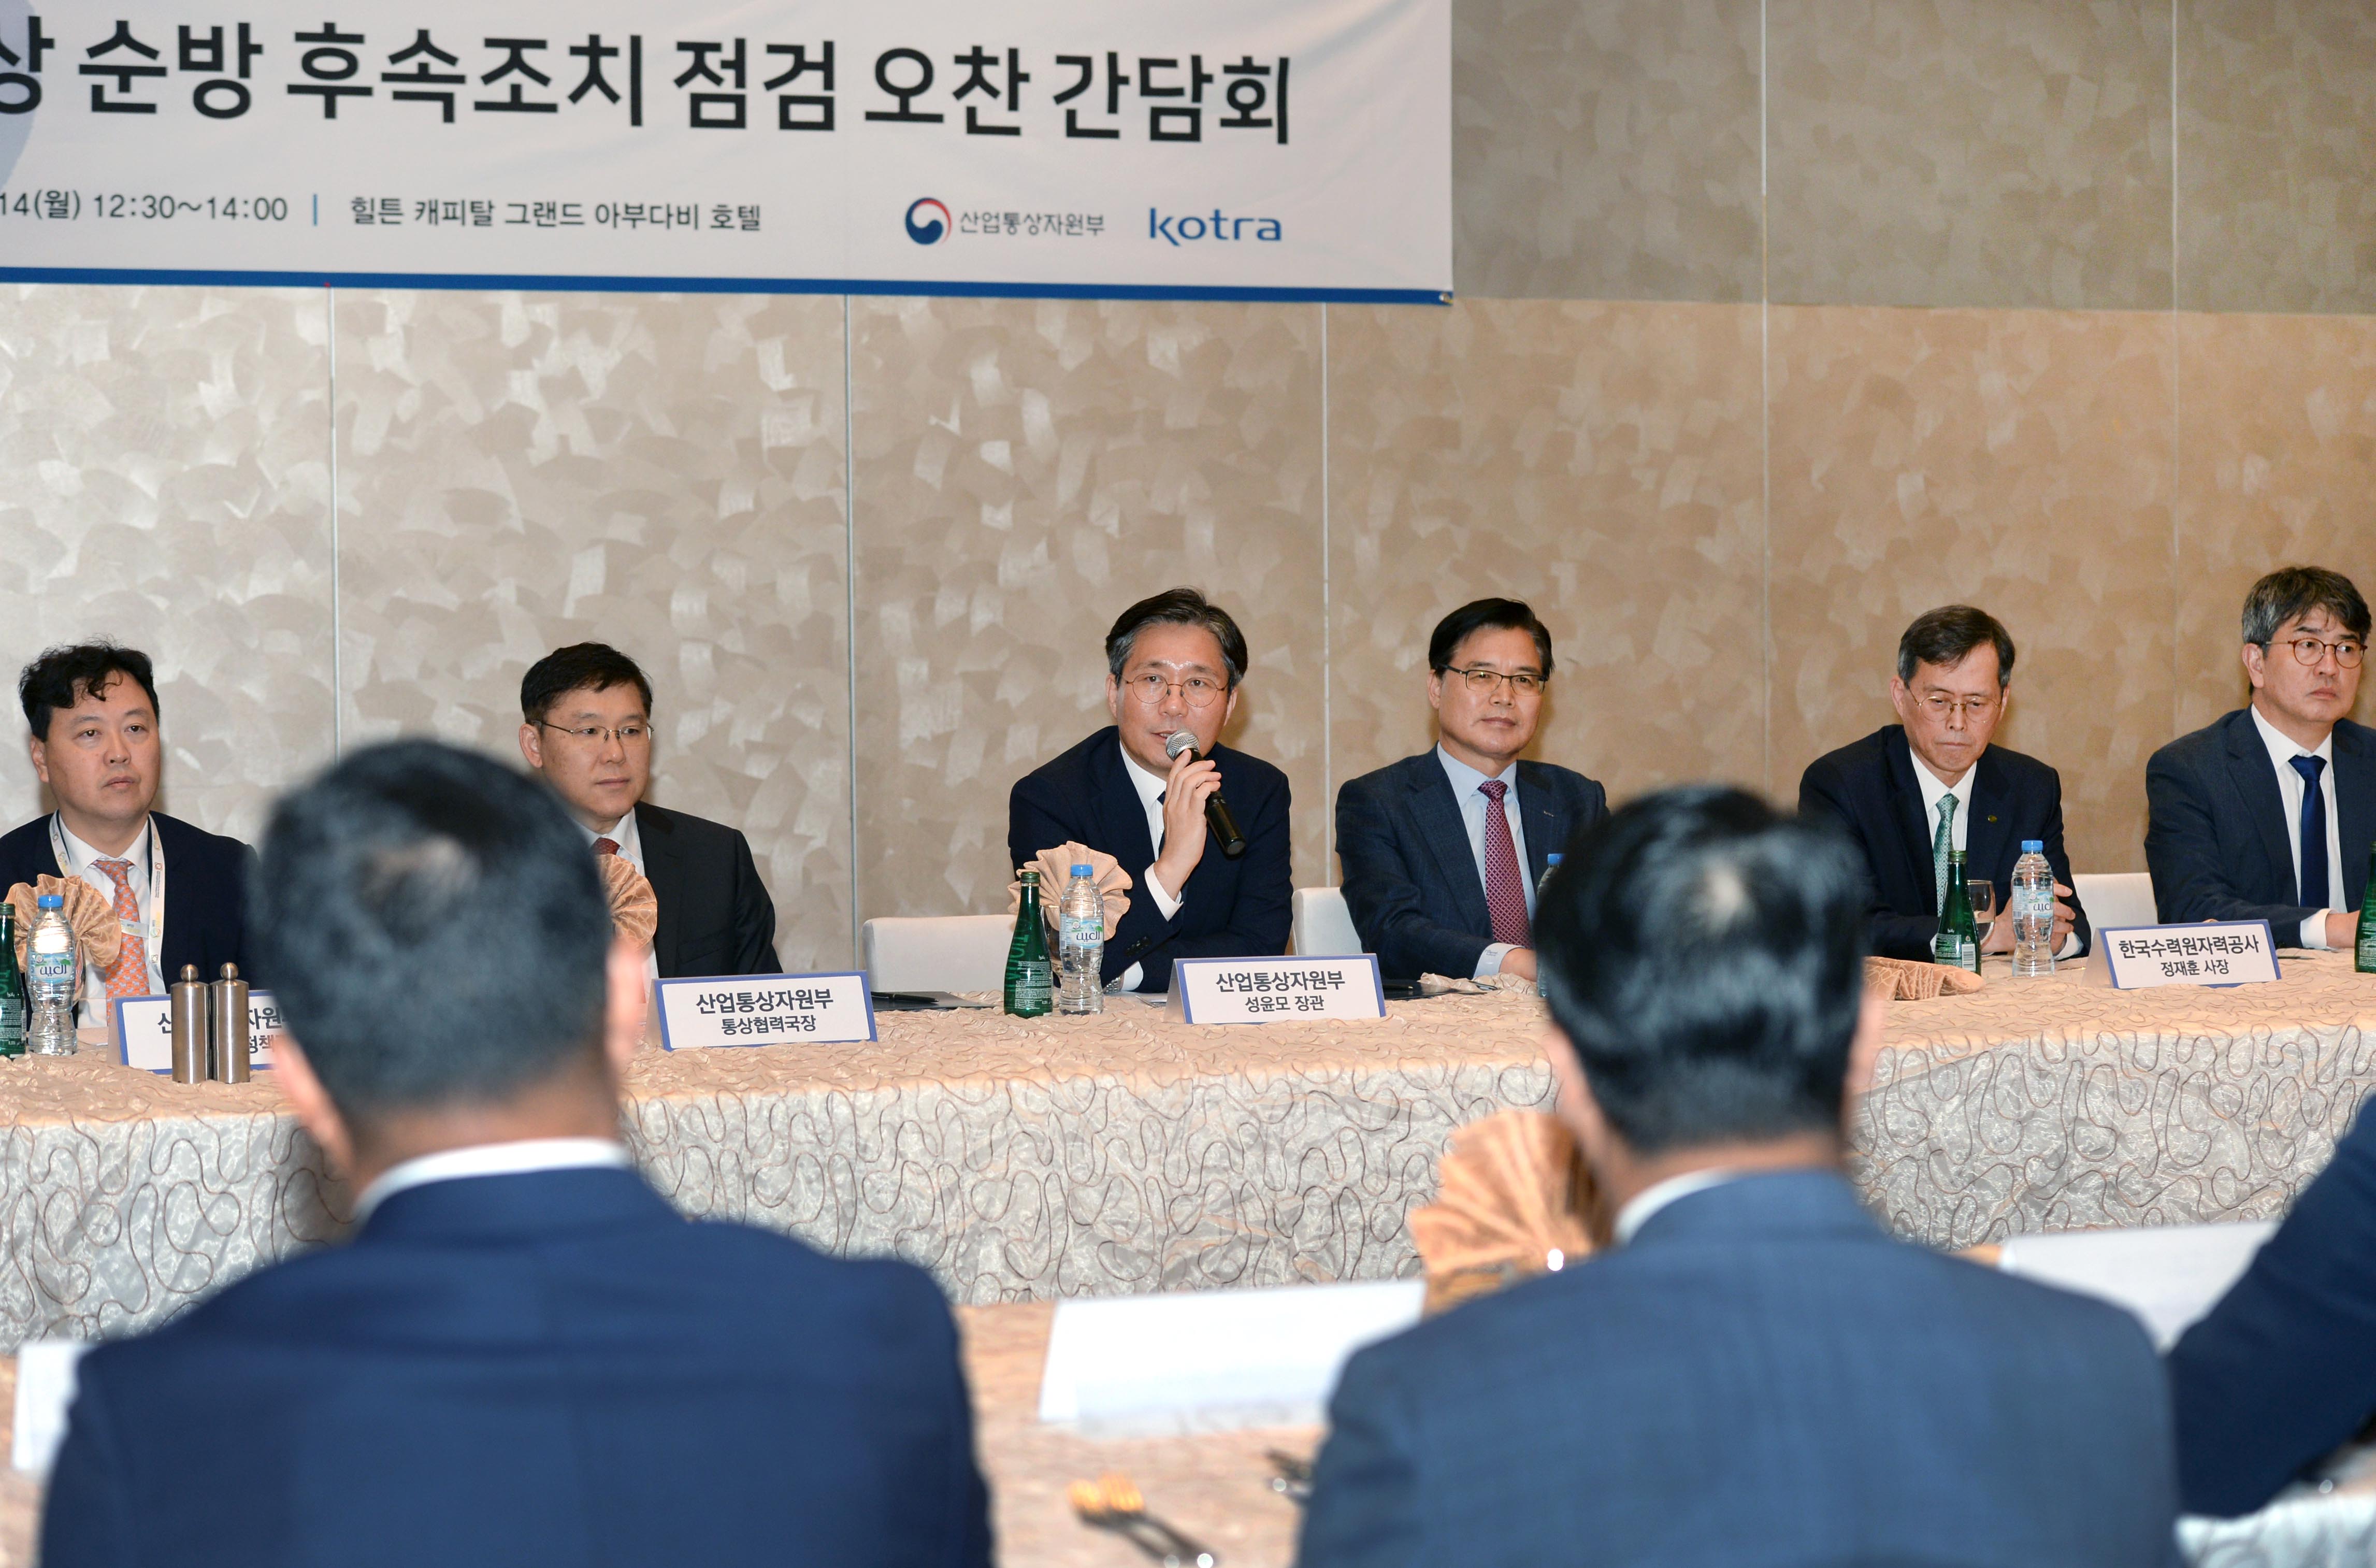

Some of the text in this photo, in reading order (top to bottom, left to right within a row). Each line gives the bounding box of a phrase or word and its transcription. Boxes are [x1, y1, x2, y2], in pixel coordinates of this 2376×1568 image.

[79, 20, 263, 119] 순방
[287, 22, 642, 127] 후속조치
[674, 38, 834, 132] 점검
[865, 46, 1030, 136] 오찬
[1053, 51, 1290, 145] 간담회
[351, 197, 404, 225] 힐튼
[415, 199, 495, 227] 캐피탈
[505, 202, 585, 228] 그랜드
[595, 202, 699, 231] 아부다비
[710, 205, 760, 232] 호텔
[960, 211, 1105, 237] 산업통상자원부
[1149, 208, 1282, 247] kotra
[2118, 934, 2259, 959] 한국수력원자력공사
[2160, 959, 2229, 977] 정재훈 사장
[1216, 970, 1346, 992] 산업통상자원부
[696, 988, 834, 1014] 산업통상자원부
[1245, 995, 1324, 1013] 성윤모 장관
[721, 1014, 816, 1035] 통상협력국장
